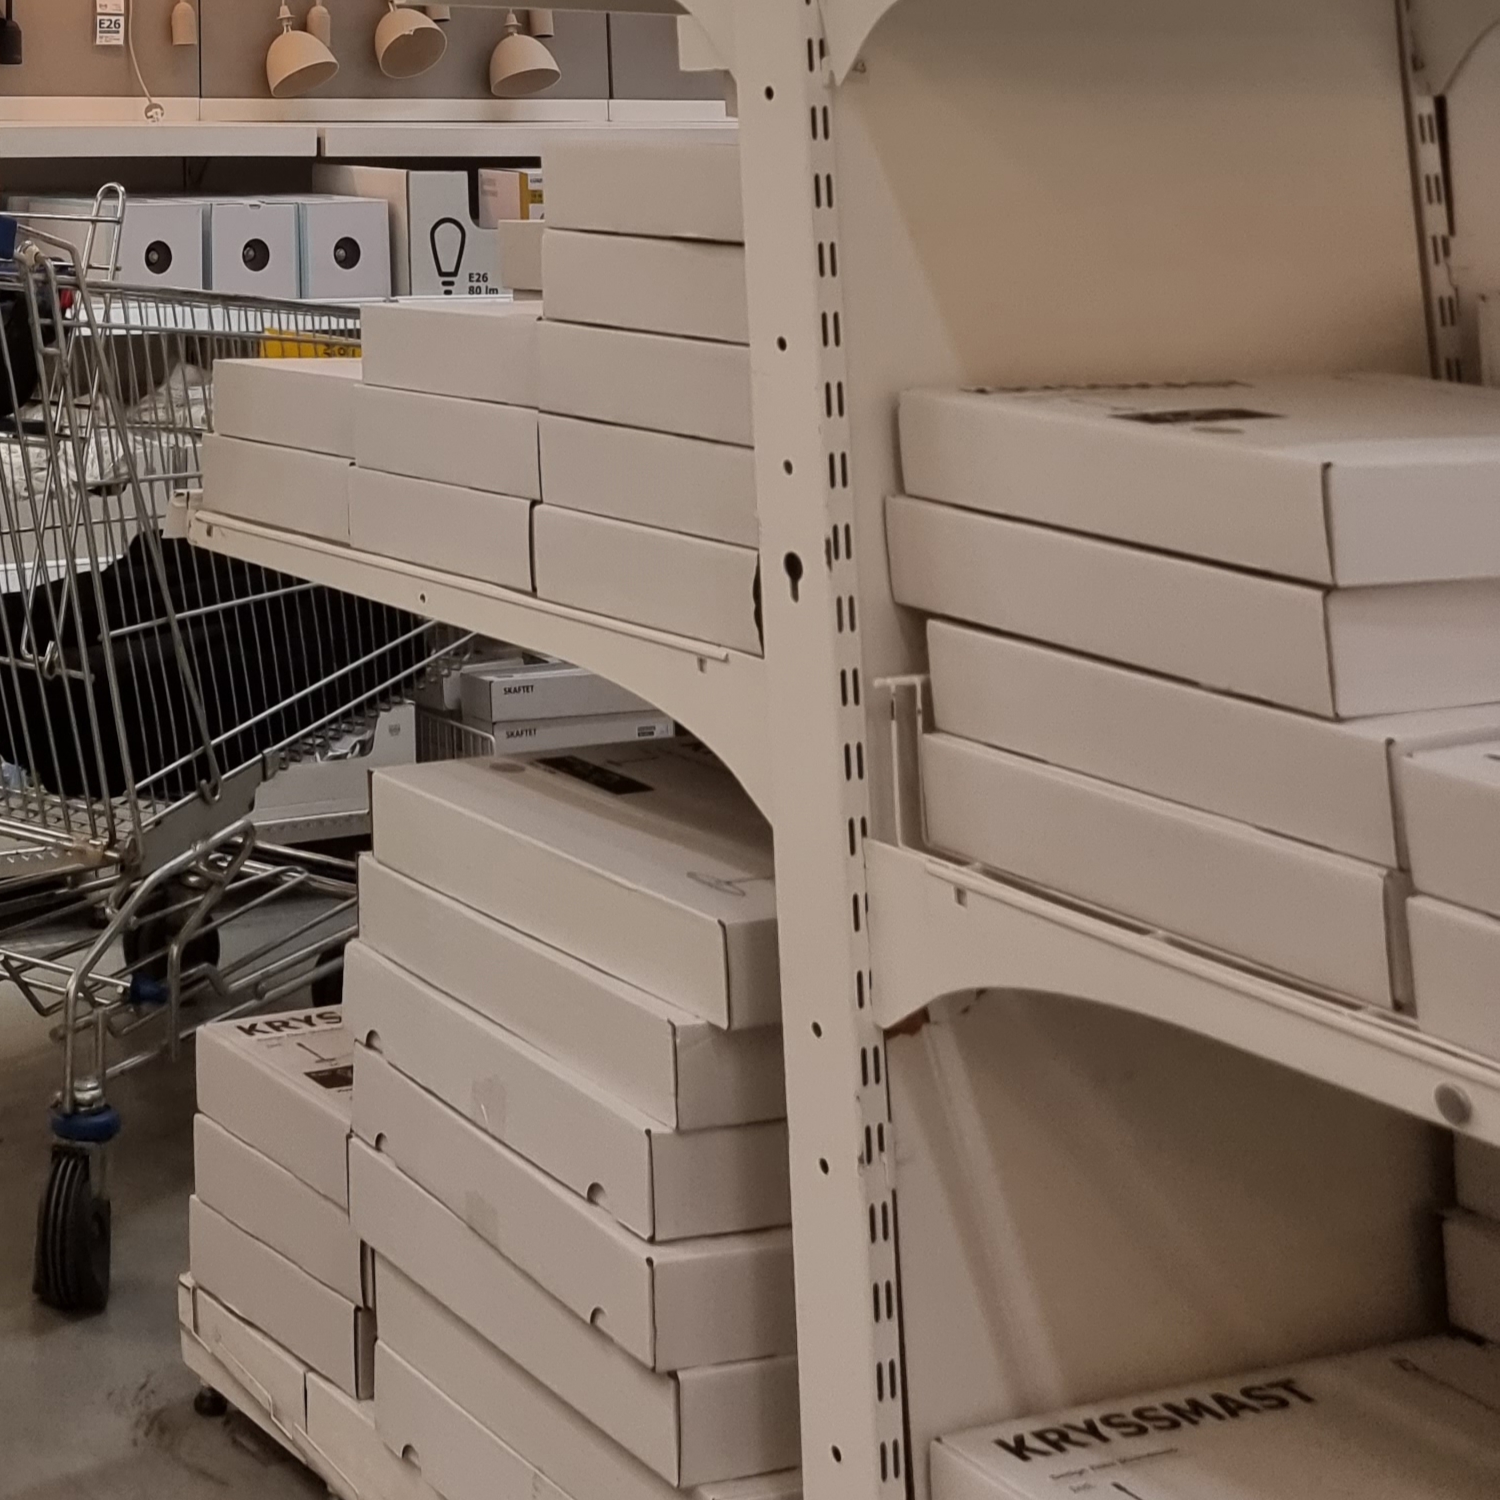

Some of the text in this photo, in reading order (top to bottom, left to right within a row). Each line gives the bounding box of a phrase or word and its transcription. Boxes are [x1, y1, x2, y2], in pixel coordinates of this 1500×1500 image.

[99, 18, 121, 30] E26
[468, 272, 488, 283] E26
[468, 285, 499, 295] 80 lm
[503, 684, 534, 695] SKAFTET
[506, 728, 537, 739] SKAFTET
[994, 1377, 1319, 1462] KRYSSMAST
